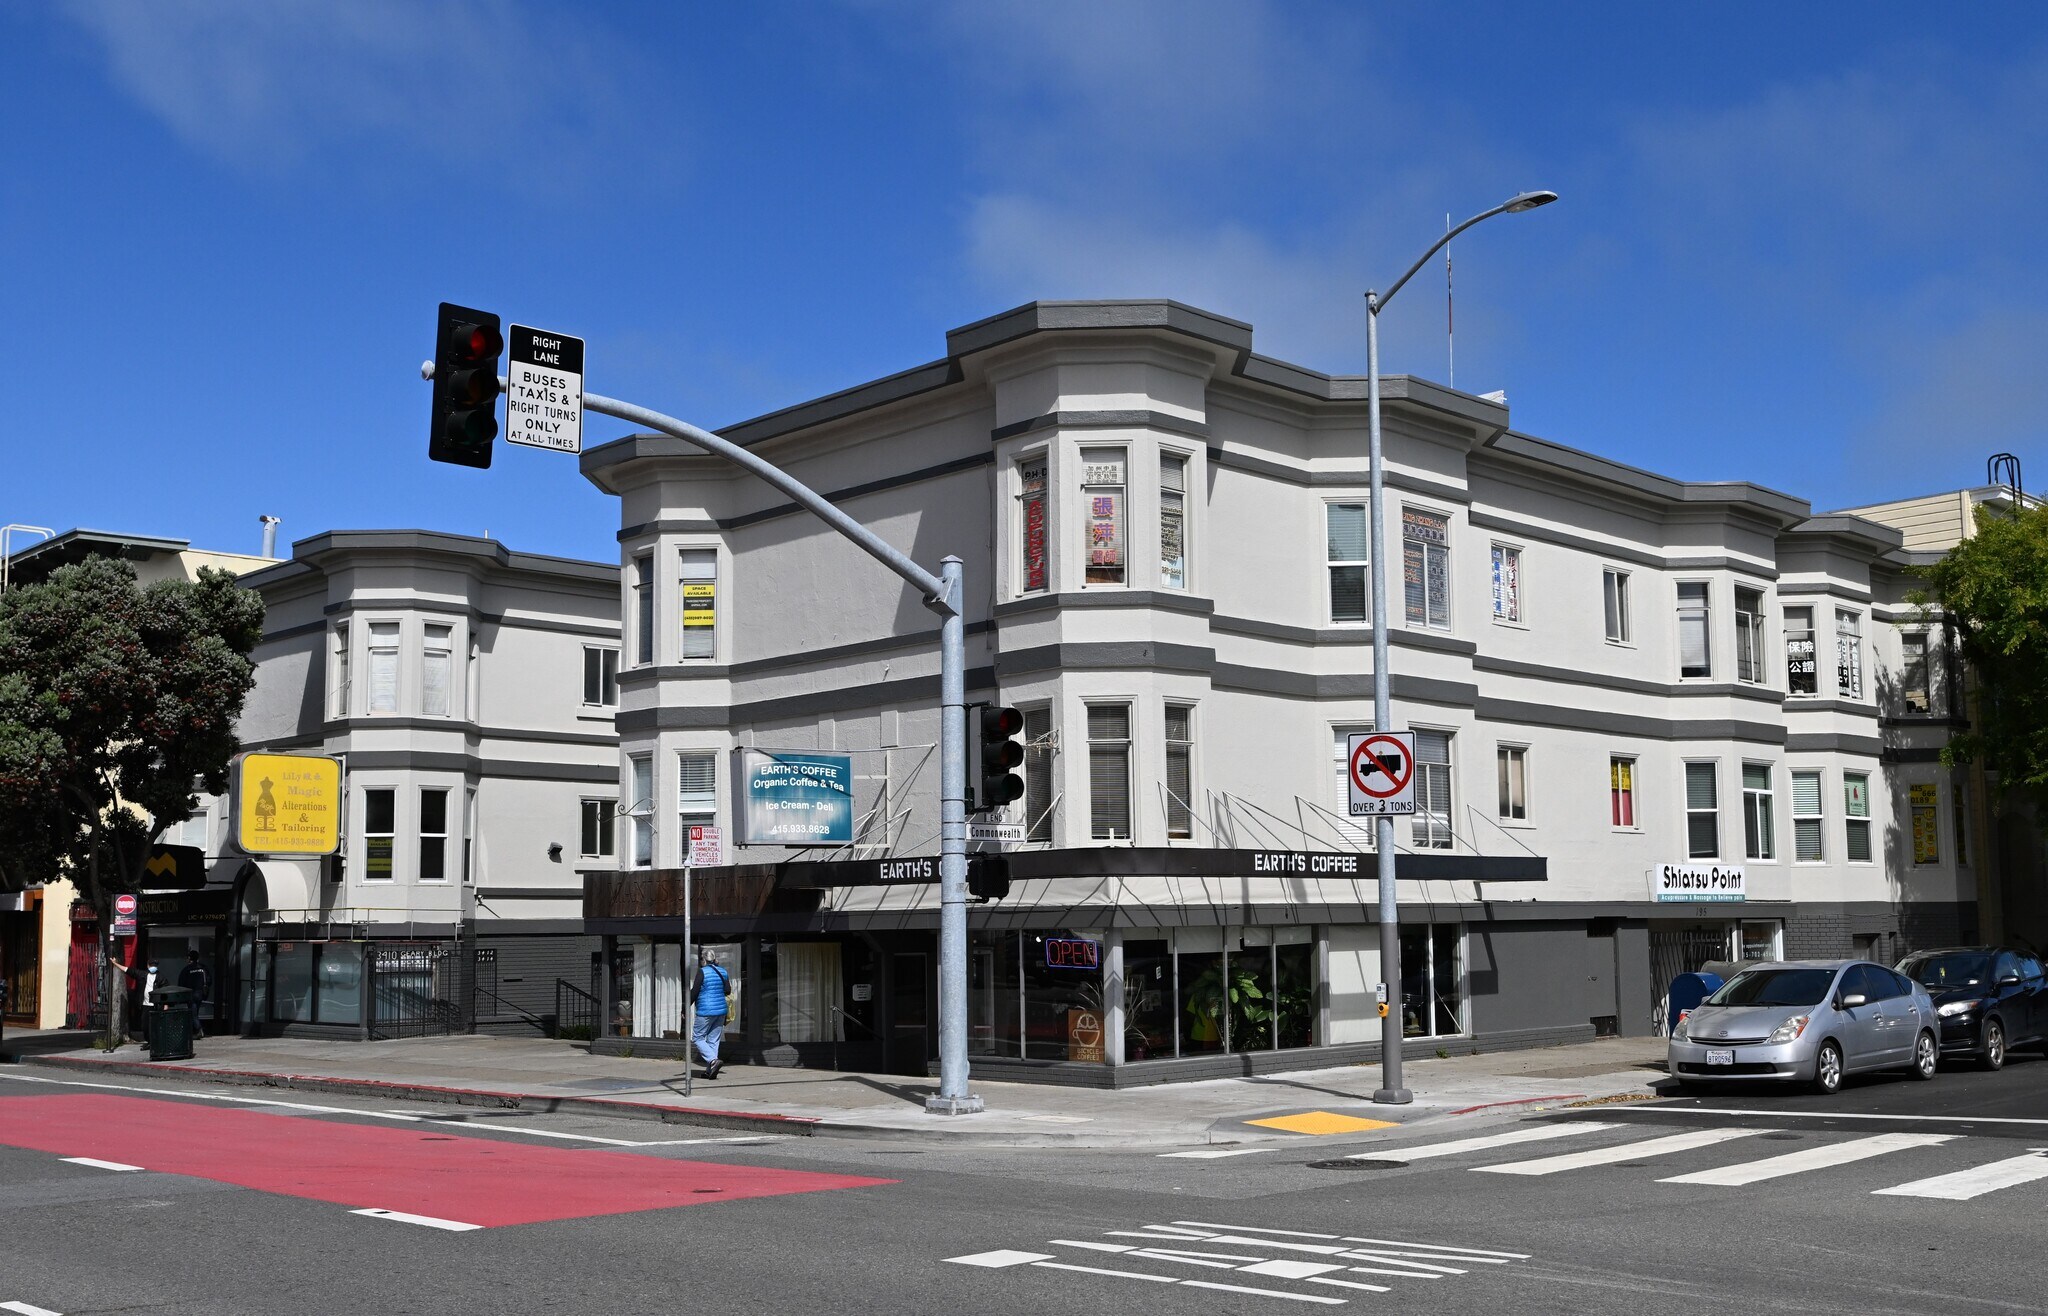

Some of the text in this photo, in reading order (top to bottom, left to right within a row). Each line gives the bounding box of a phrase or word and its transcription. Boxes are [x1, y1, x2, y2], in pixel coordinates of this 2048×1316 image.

[532, 336, 561, 350] RIGHT
[534, 350, 560, 365] LANE
[523, 372, 566, 389] BUSES
[518, 386, 570, 405] TAXIS &
[510, 400, 577, 422] RIGHT TURNS
[525, 418, 561, 433] ONLY
[511, 430, 574, 448] AT ALL TIMES
[1788, 640, 1814, 653] 保險
[1789, 660, 1815, 673] 公證
[1851, 638, 1860, 691] FARMERS
[761, 765, 837, 777] EARTH'S COFFEE
[754, 777, 845, 791] Organic Coffee & Tea
[288, 785, 322, 798] Magic
[281, 800, 327, 811] Alterations
[766, 801, 779, 810] Ice
[781, 801, 809, 810] Cream
[817, 801, 834, 811] Deli
[1353, 799, 1412, 812] OVER 3 TONS
[299, 812, 309, 822] &
[991, 814, 1003, 822] END
[281, 823, 326, 834] Tailoring
[691, 828, 701, 838] NO
[971, 826, 1021, 838] Commonwealth
[880, 858, 932, 879] EARTH'S
[1254, 853, 1357, 872] EARTH'S COFFEE
[1663, 865, 1741, 889] Shiatsu Point
[1696, 907, 1707, 916] 195
[1048, 941, 1096, 966] OPEN
